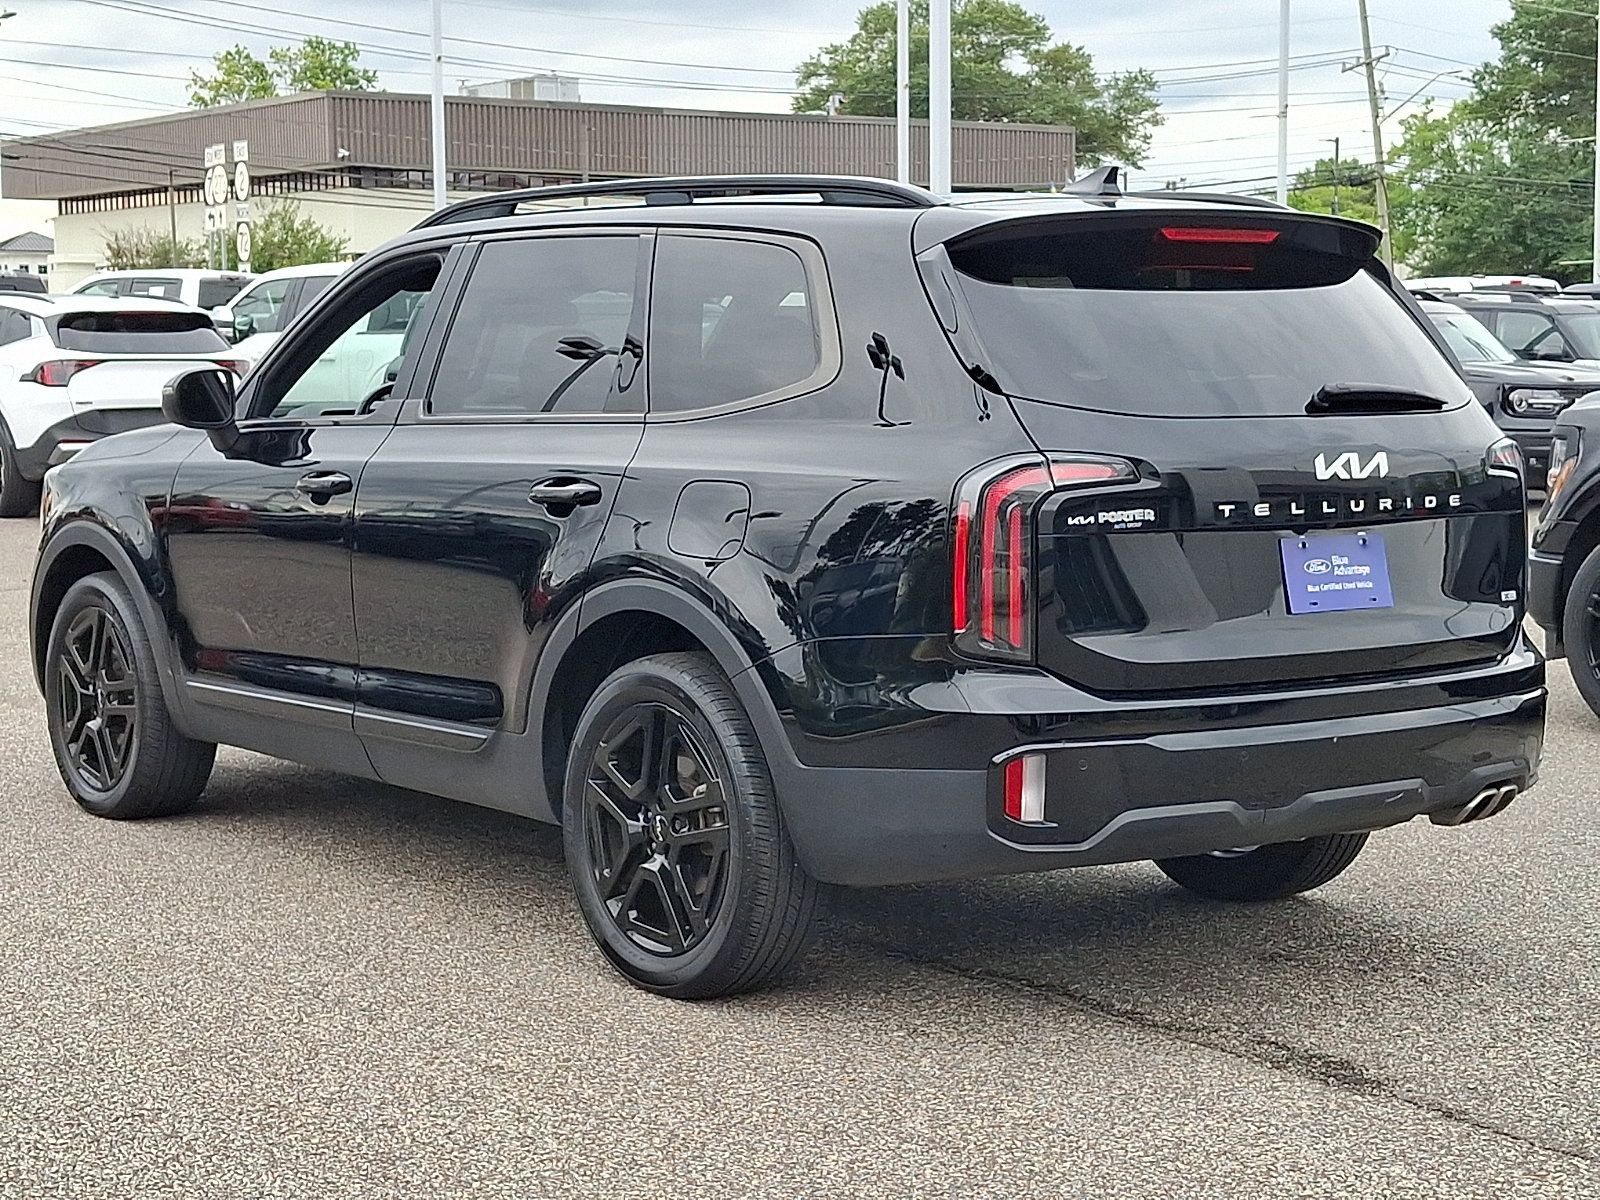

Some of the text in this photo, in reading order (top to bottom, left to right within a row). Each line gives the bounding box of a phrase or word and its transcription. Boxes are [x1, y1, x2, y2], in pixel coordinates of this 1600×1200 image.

[1313, 451, 1389, 480] KIA
[1218, 493, 1463, 518] TELLURIDE
[1067, 508, 1156, 525] KIA PORTER
[1331, 555, 1349, 566] Blue
[1333, 565, 1371, 576] Advantage
[1306, 584, 1320, 592] Blue
[1320, 582, 1343, 591] Certified
